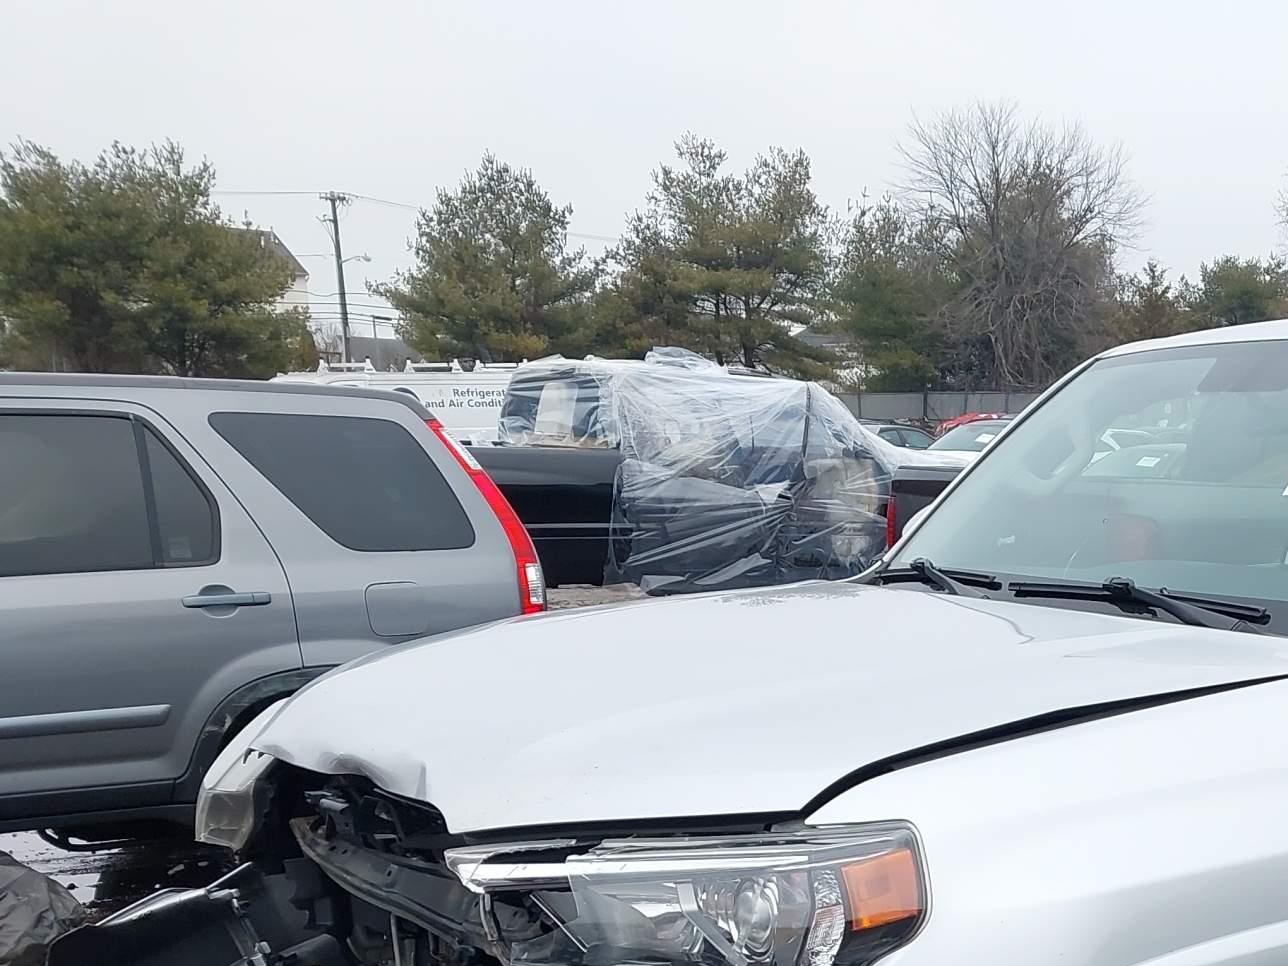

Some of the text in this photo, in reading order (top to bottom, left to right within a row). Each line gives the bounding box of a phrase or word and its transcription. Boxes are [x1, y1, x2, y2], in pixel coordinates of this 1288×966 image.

[453, 388, 505, 399] Refrigerat
[425, 399, 445, 408] and
[449, 399, 464, 408] Air
